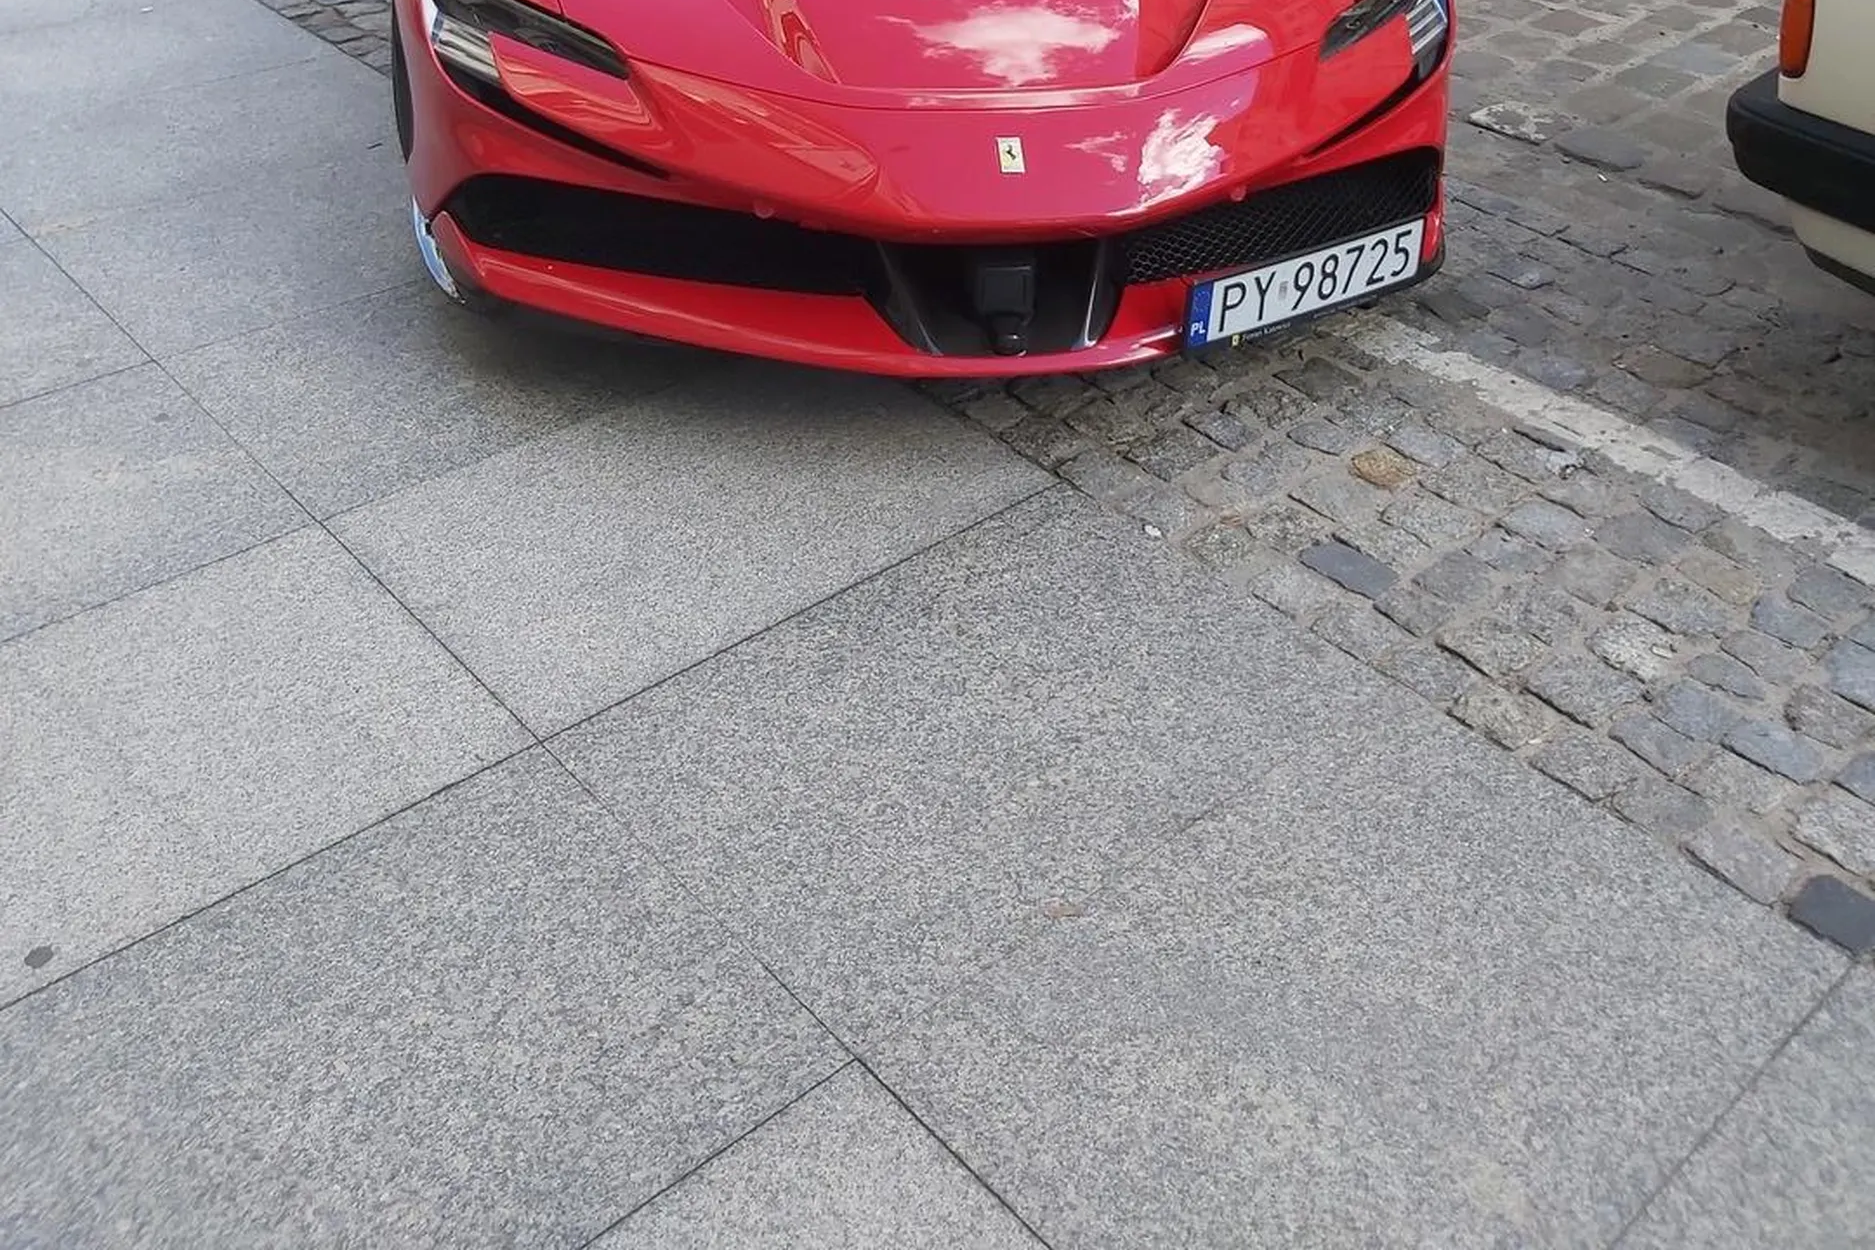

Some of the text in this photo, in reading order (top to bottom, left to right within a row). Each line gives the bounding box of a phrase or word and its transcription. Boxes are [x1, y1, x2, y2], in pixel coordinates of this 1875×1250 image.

[1218, 229, 1413, 333] PY 98725
[1190, 321, 1206, 338] PL
